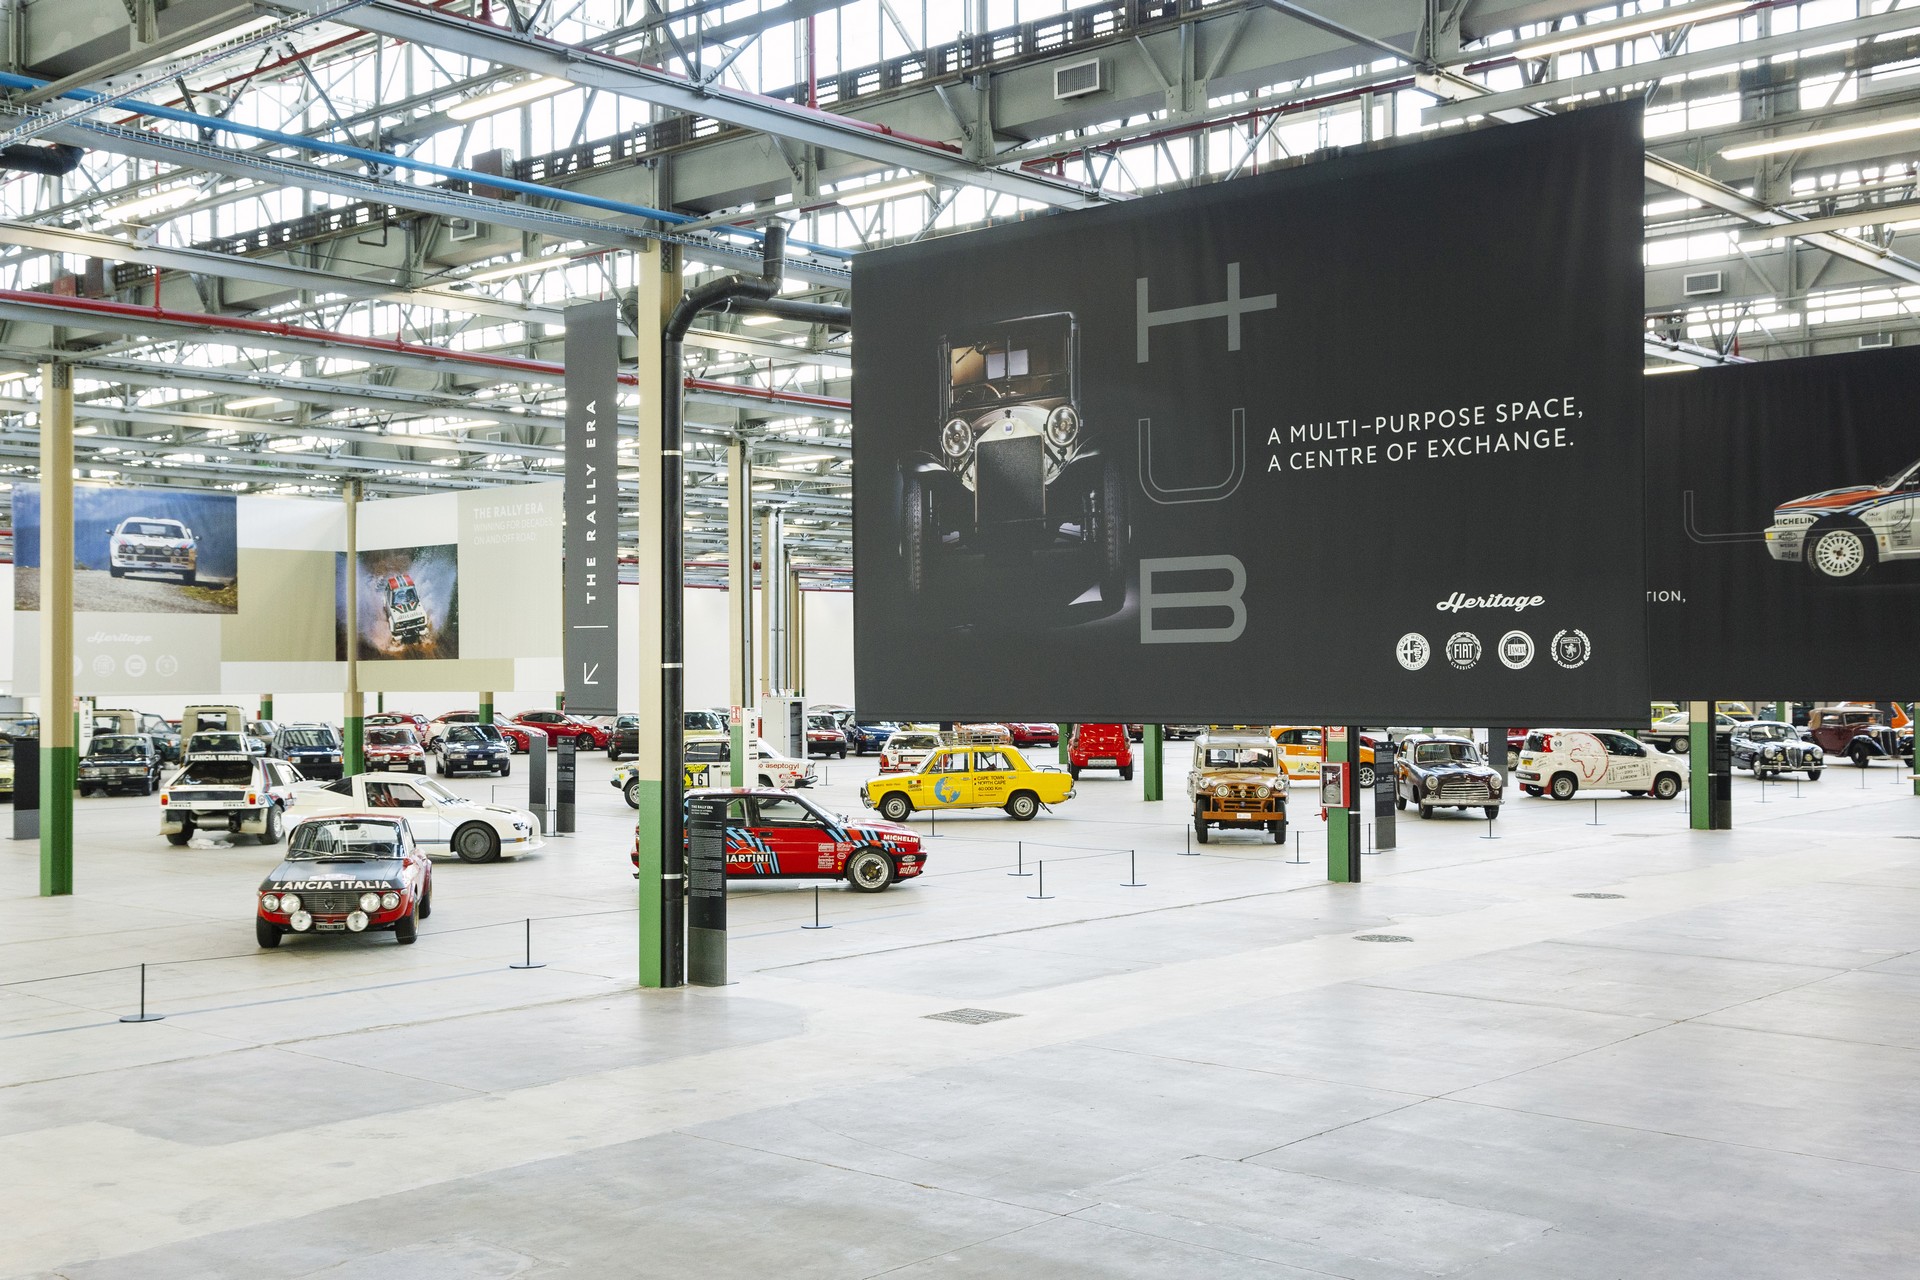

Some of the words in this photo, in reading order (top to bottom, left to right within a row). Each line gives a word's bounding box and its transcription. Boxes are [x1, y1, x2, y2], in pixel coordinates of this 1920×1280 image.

[586, 400, 596, 450] ERA
[1267, 428, 1282, 445] A
[1290, 406, 1486, 443] MULTI-PURPOSE
[1496, 396, 1584, 423] SPACE,
[1267, 454, 1282, 472] A
[1290, 445, 1378, 470] CENTRE
[1386, 441, 1418, 462] OF
[1428, 428, 1574, 458] EXCHANGE.
[474, 507, 492, 519] THE
[494, 504, 522, 518] RALLY
[525, 502, 544, 514] ERA
[586, 463, 596, 542] RALLY
[586, 556, 596, 604] THE
[1436, 592, 1546, 614] Heritage
[86, 631, 152, 645] Heritage
[1454, 644, 1473, 658] FIAT
[1558, 660, 1584, 669] CLASSICHE
[698, 774, 703, 786] 6
[884, 834, 918, 843] MICHELIN
[272, 880, 392, 890] LANCIA-ITALIA
